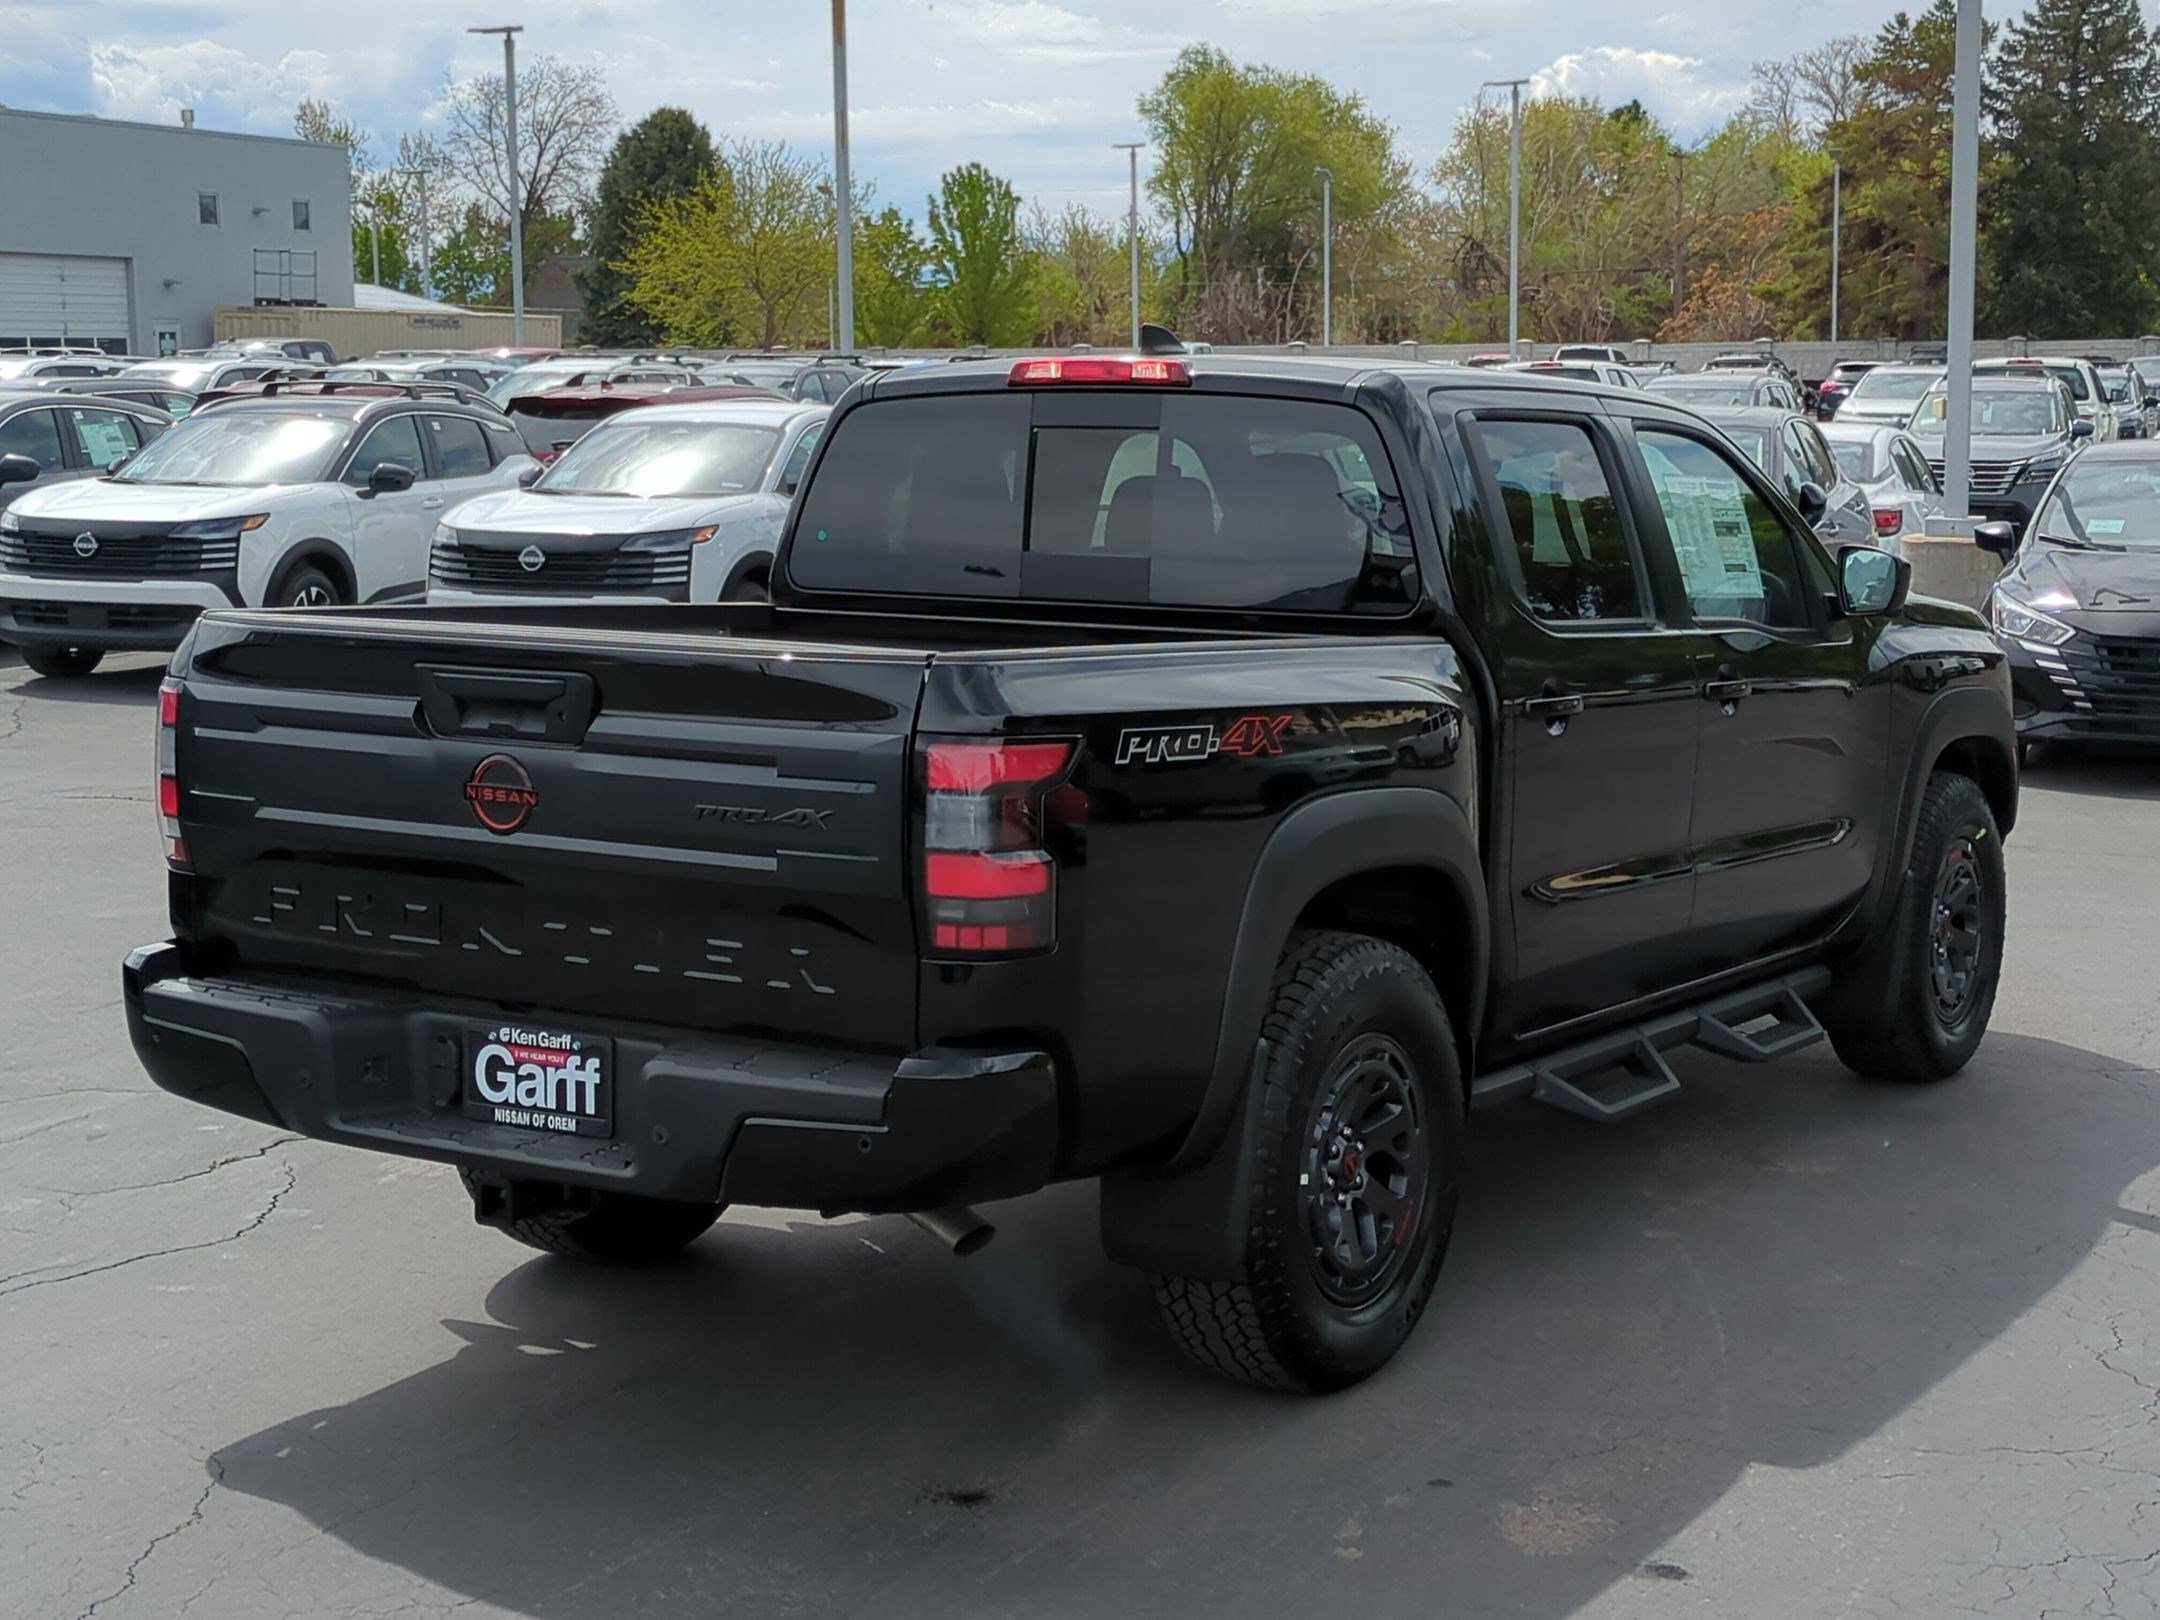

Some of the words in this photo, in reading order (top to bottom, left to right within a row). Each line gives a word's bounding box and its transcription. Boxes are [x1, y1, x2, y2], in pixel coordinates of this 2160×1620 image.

[466, 786, 537, 807] NISSAN
[252, 885, 835, 994] FRONTIER
[511, 1028, 537, 1046] Ken
[538, 1031, 571, 1050] Garff
[475, 1044, 600, 1115] Garff
[494, 1108, 531, 1126] NISSAN
[532, 1114, 545, 1127] OF
[547, 1117, 576, 1132] OREM
